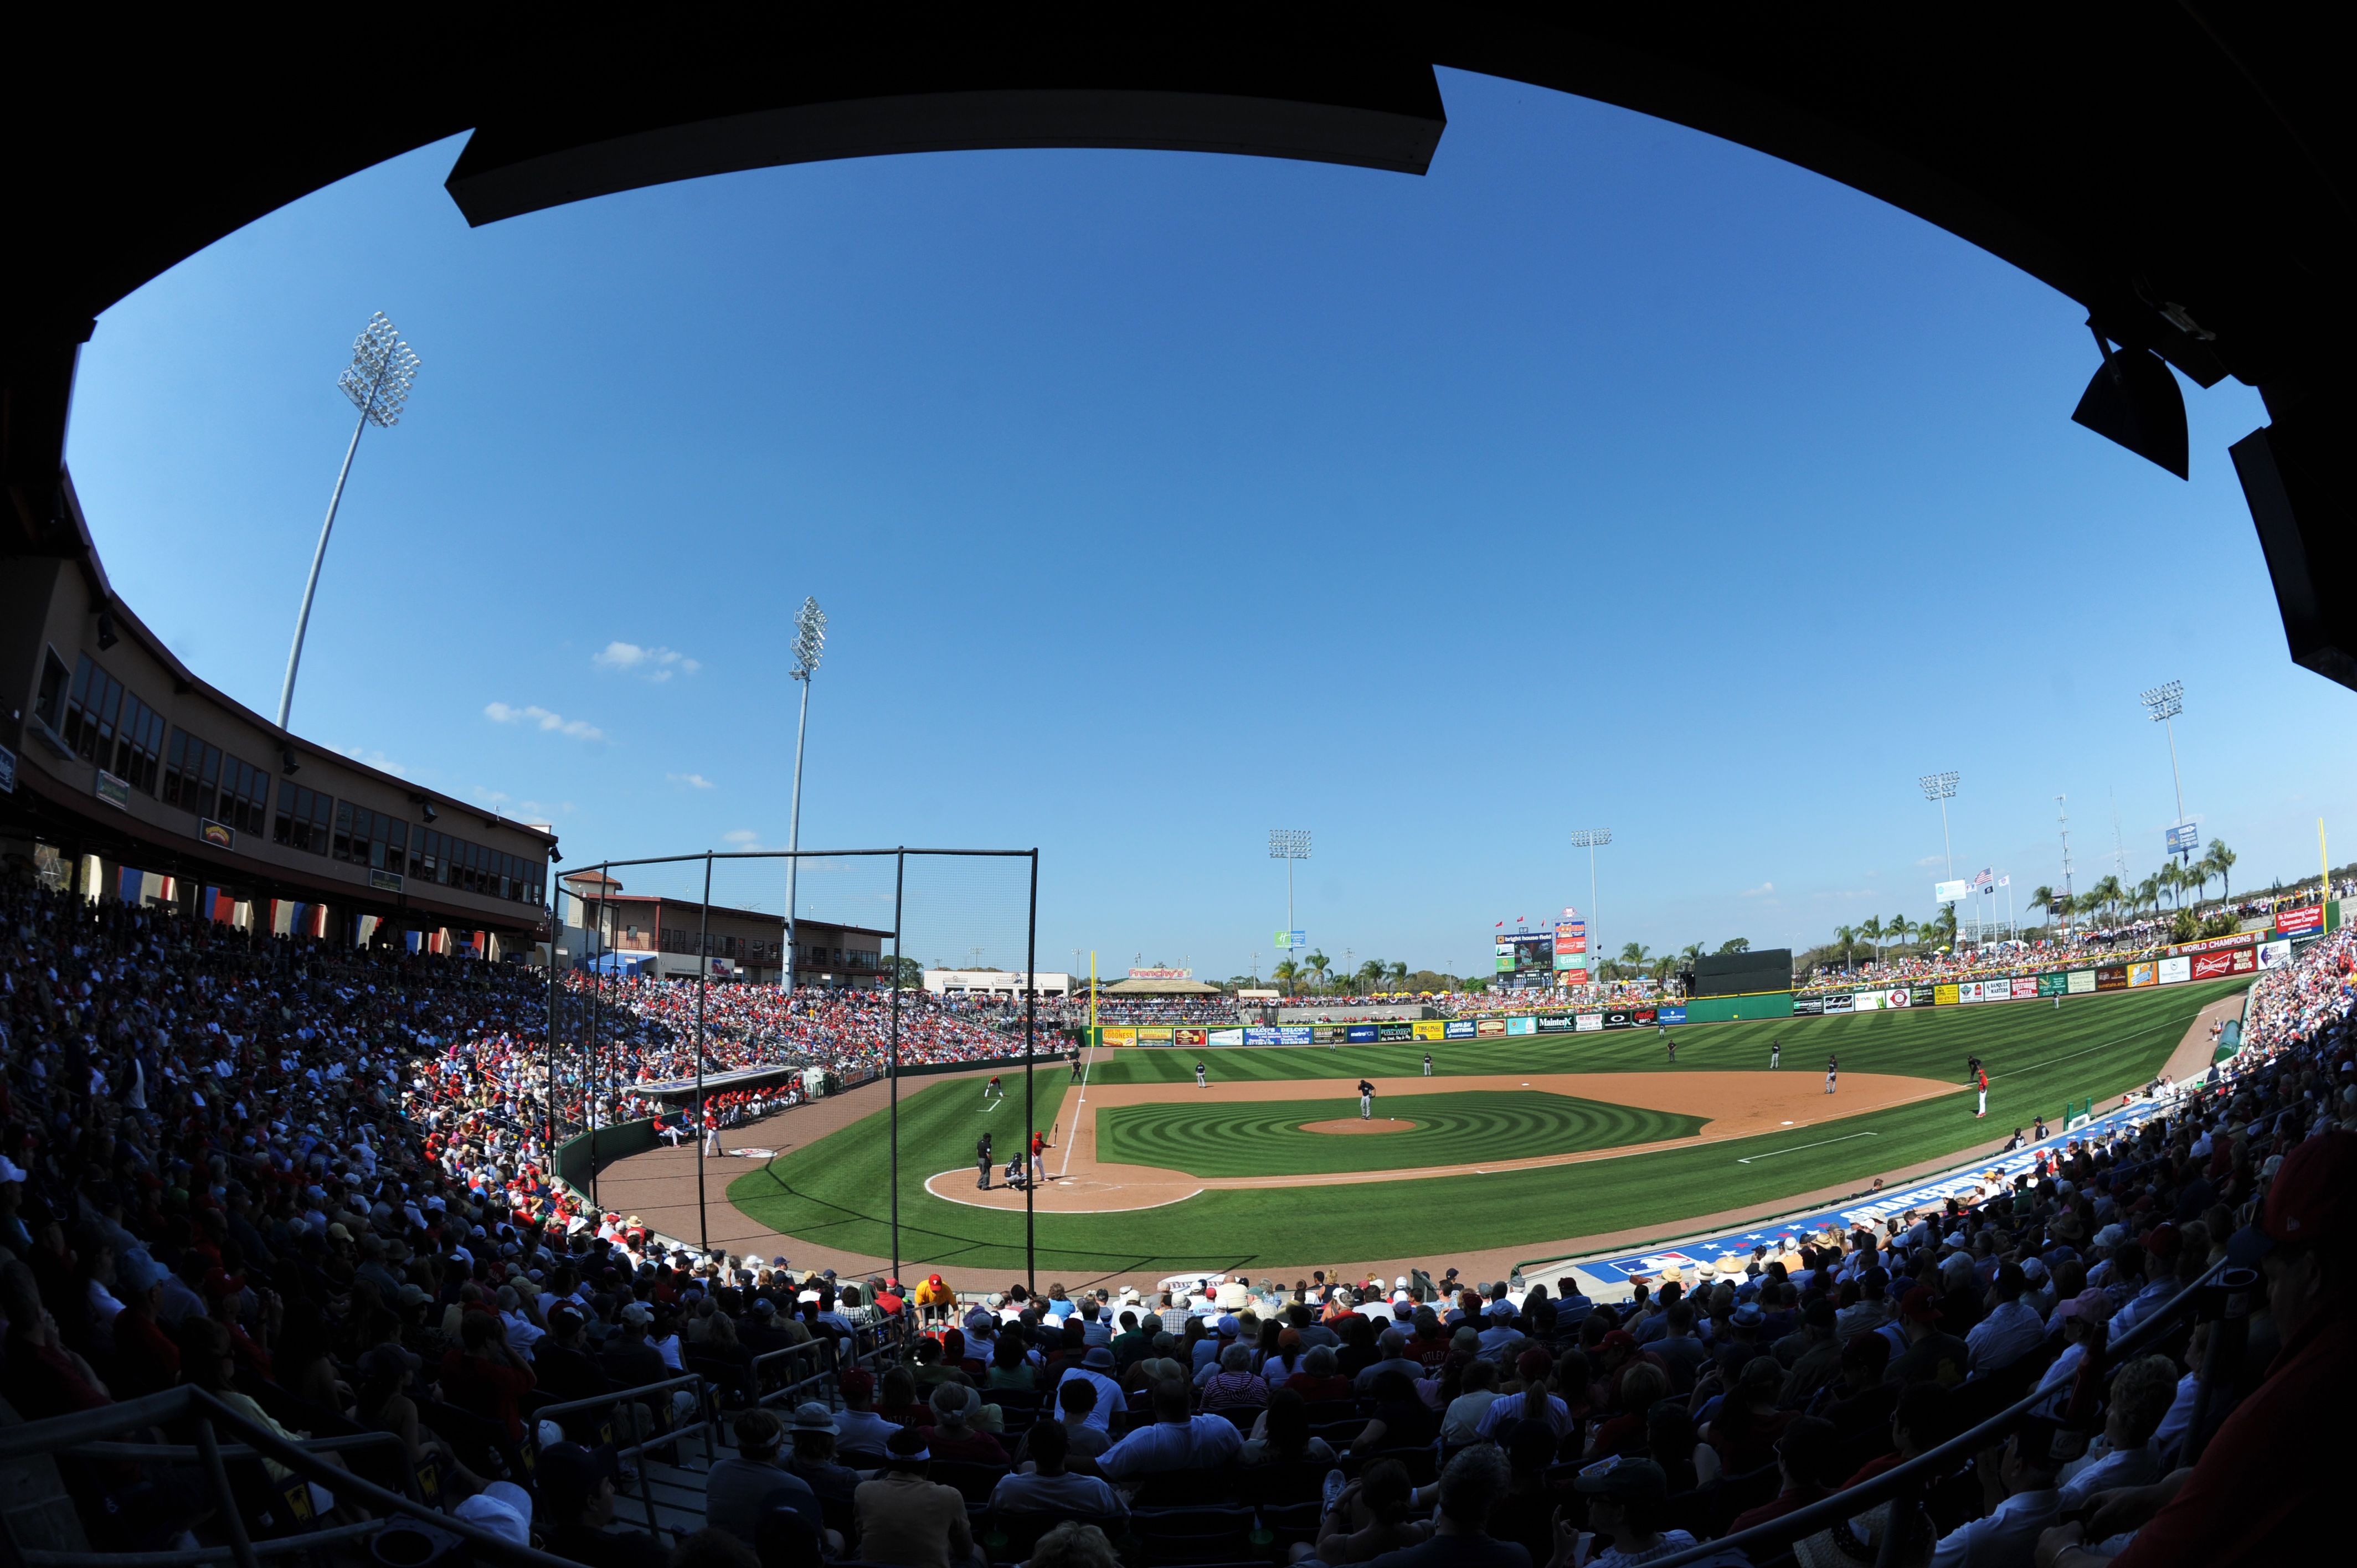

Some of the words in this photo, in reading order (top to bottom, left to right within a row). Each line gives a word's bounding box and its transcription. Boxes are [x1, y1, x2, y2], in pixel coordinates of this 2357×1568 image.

[2284, 911, 2304, 919] Petersburg
[2181, 942, 2207, 953] WORLD
[2209, 935, 2251, 948] CHAMPIONS
[2233, 950, 2252, 959] GRAB
[2195, 961, 2230, 972] Budweiser
[2234, 961, 2252, 970] BUDS
[1129, 969, 1183, 978] Frenchy's
[1635, 1010, 1655, 1019] Coca-Cola
[1539, 1017, 1572, 1028] MaintenX
[1840, 1172, 1984, 1221] GRAPEFRUIT
[1422, 1351, 1445, 1363] UTLEY
